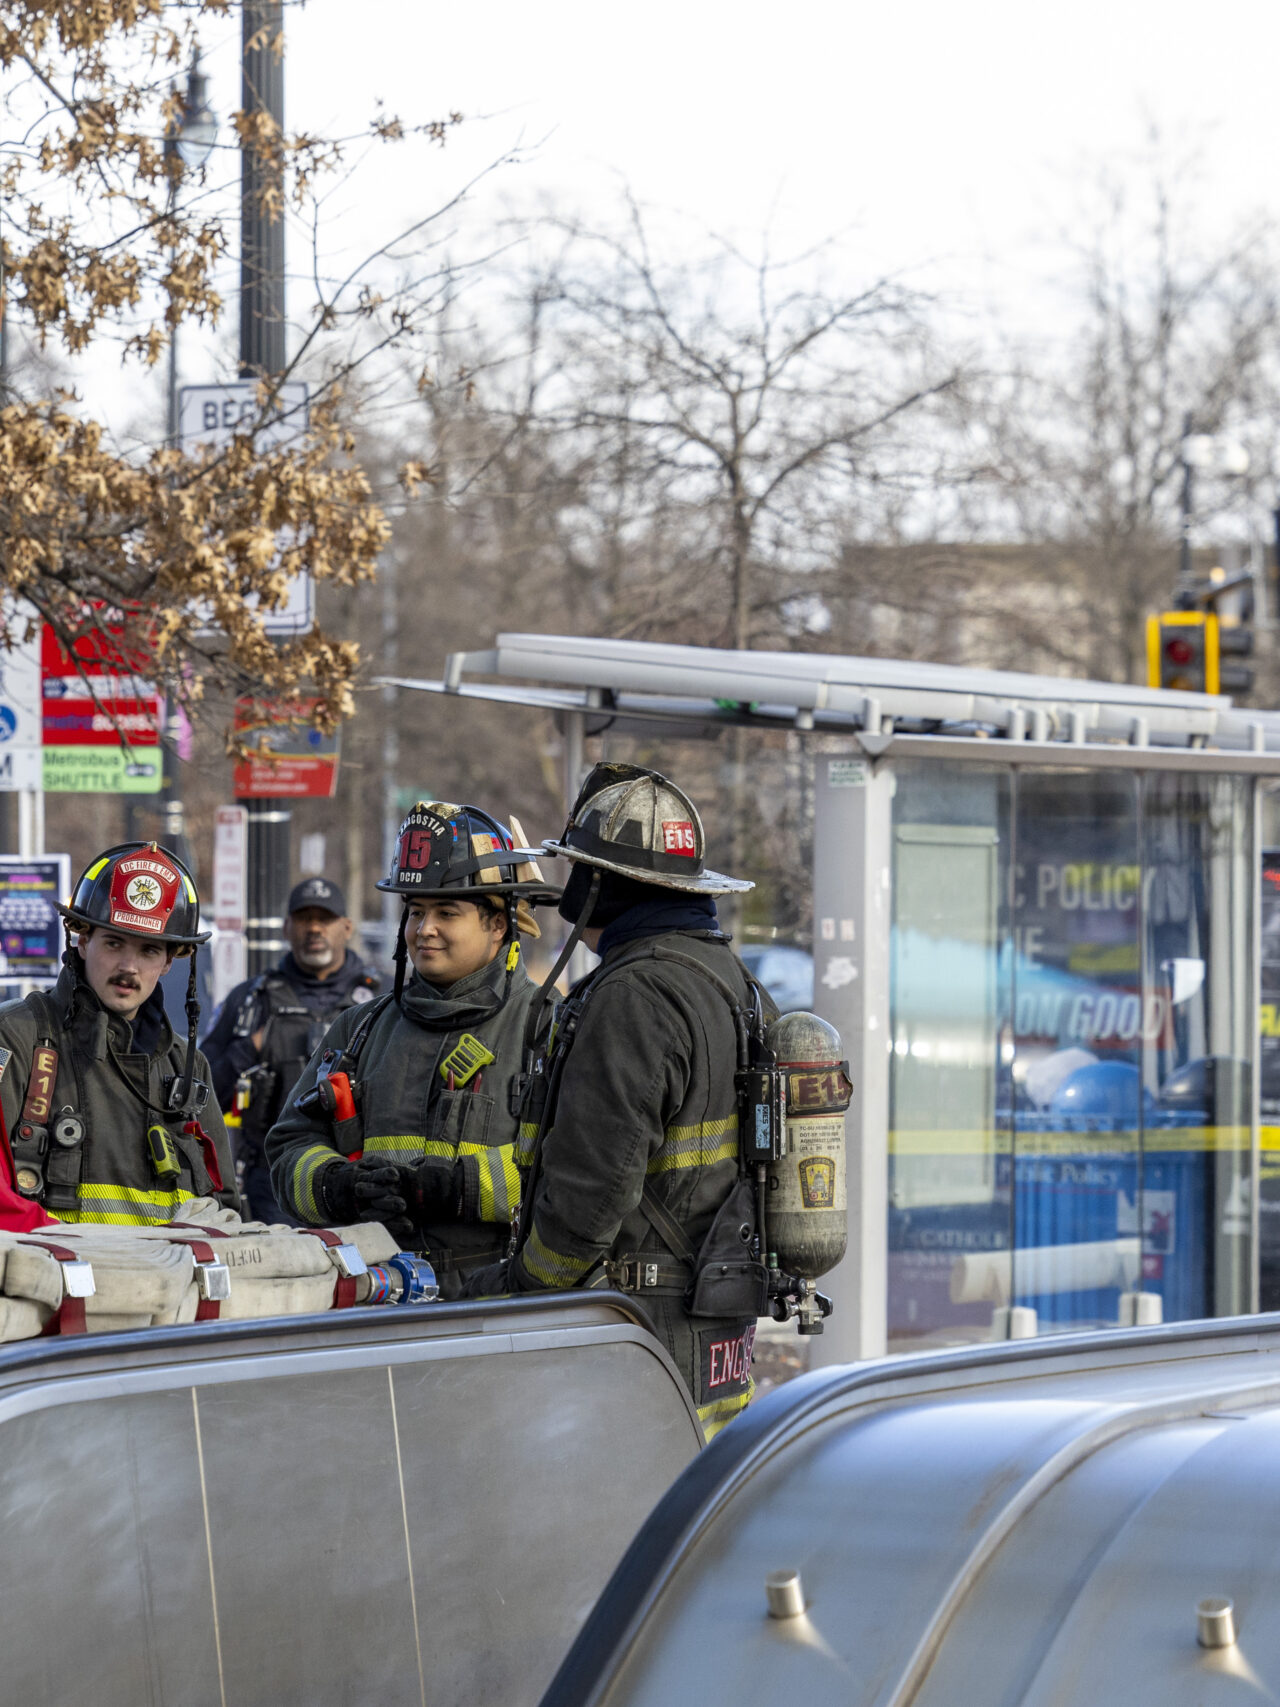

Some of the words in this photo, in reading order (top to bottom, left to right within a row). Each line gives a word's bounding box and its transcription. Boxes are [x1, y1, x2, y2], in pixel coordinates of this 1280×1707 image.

[44, 753, 120, 767] Metrobus
[44, 772, 121, 789] SHUTTLE
[665, 829, 694, 849] E15
[399, 830, 432, 869] 15
[123, 862, 134, 872] DC
[136, 861, 151, 871] FIRE
[160, 865, 174, 881] EMS
[400, 871, 422, 883] DCFD
[1037, 863, 1157, 912] POLICY
[116, 912, 159, 928] PROBATIONER
[29, 1053, 55, 1116] E15
